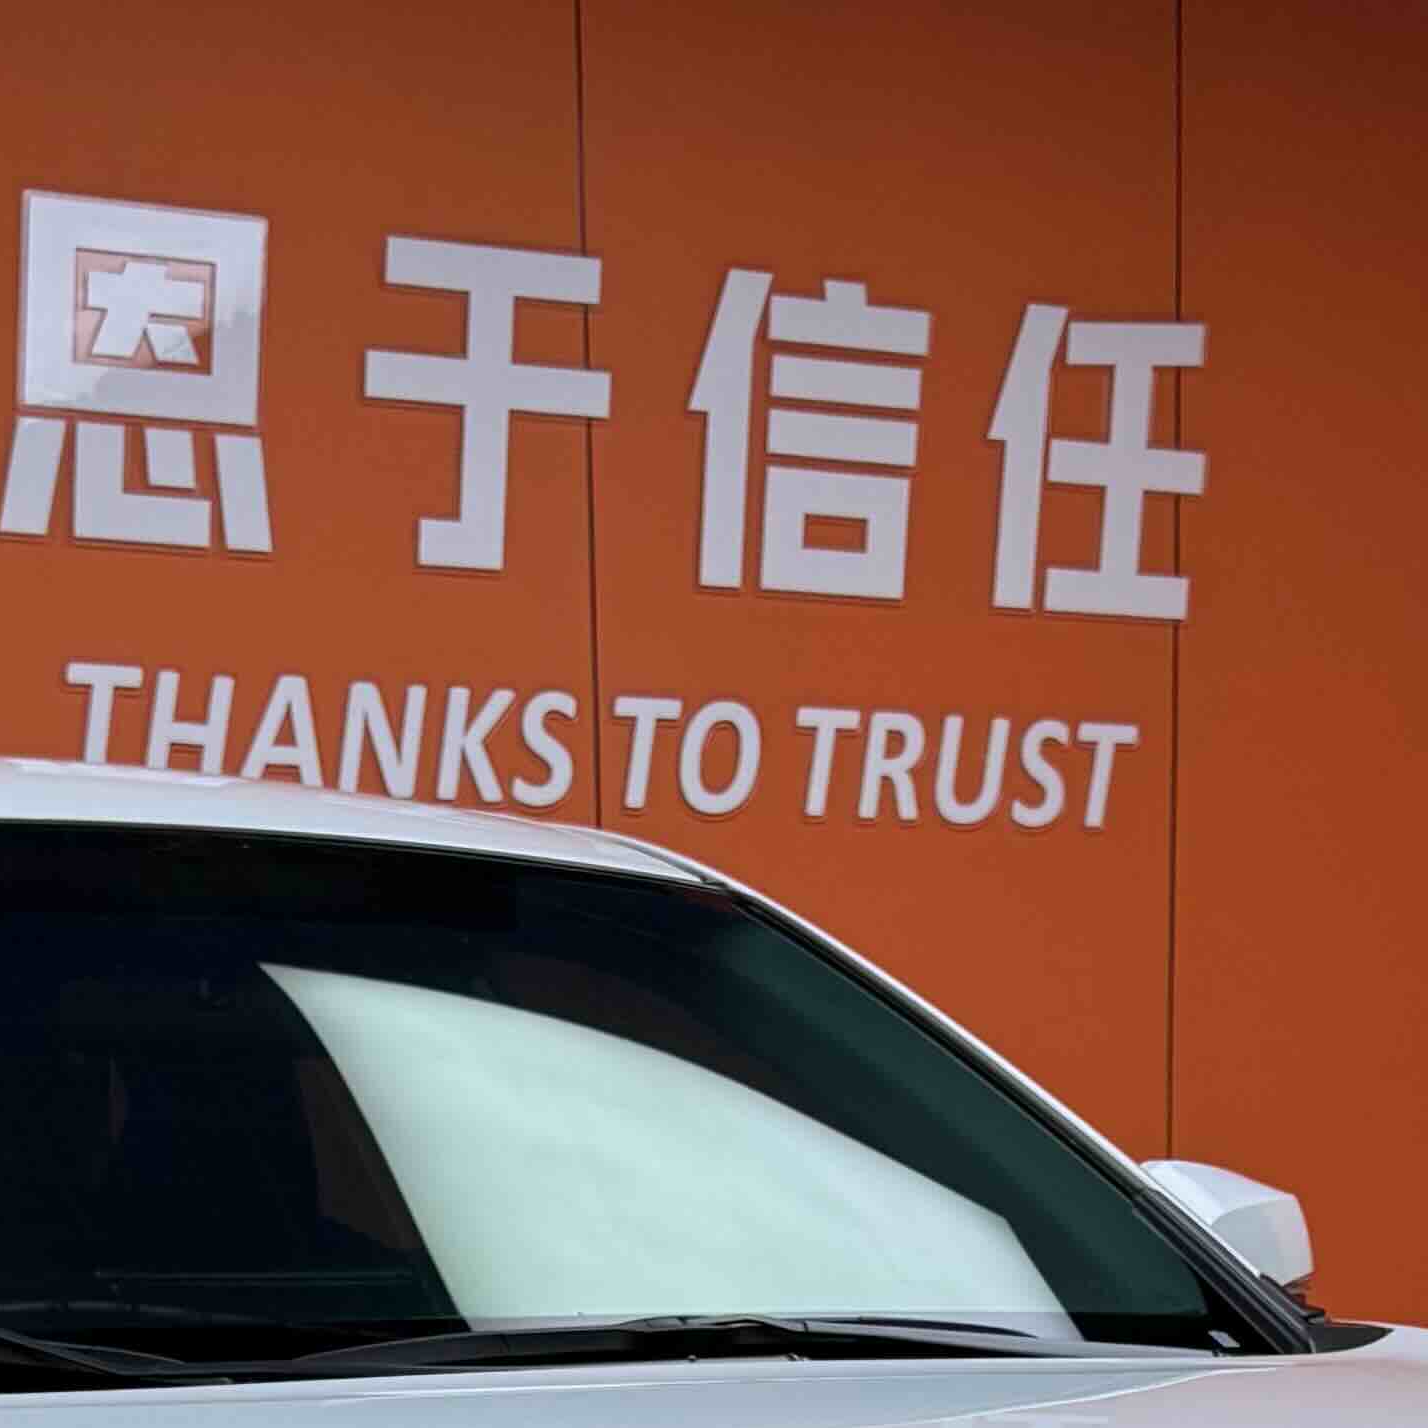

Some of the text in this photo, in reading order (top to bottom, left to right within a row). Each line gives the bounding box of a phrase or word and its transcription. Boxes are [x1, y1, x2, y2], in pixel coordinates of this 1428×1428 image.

[0, 189, 1206, 620] 恩于信任
[65, 662, 1140, 828] THANKS TO TRUST
